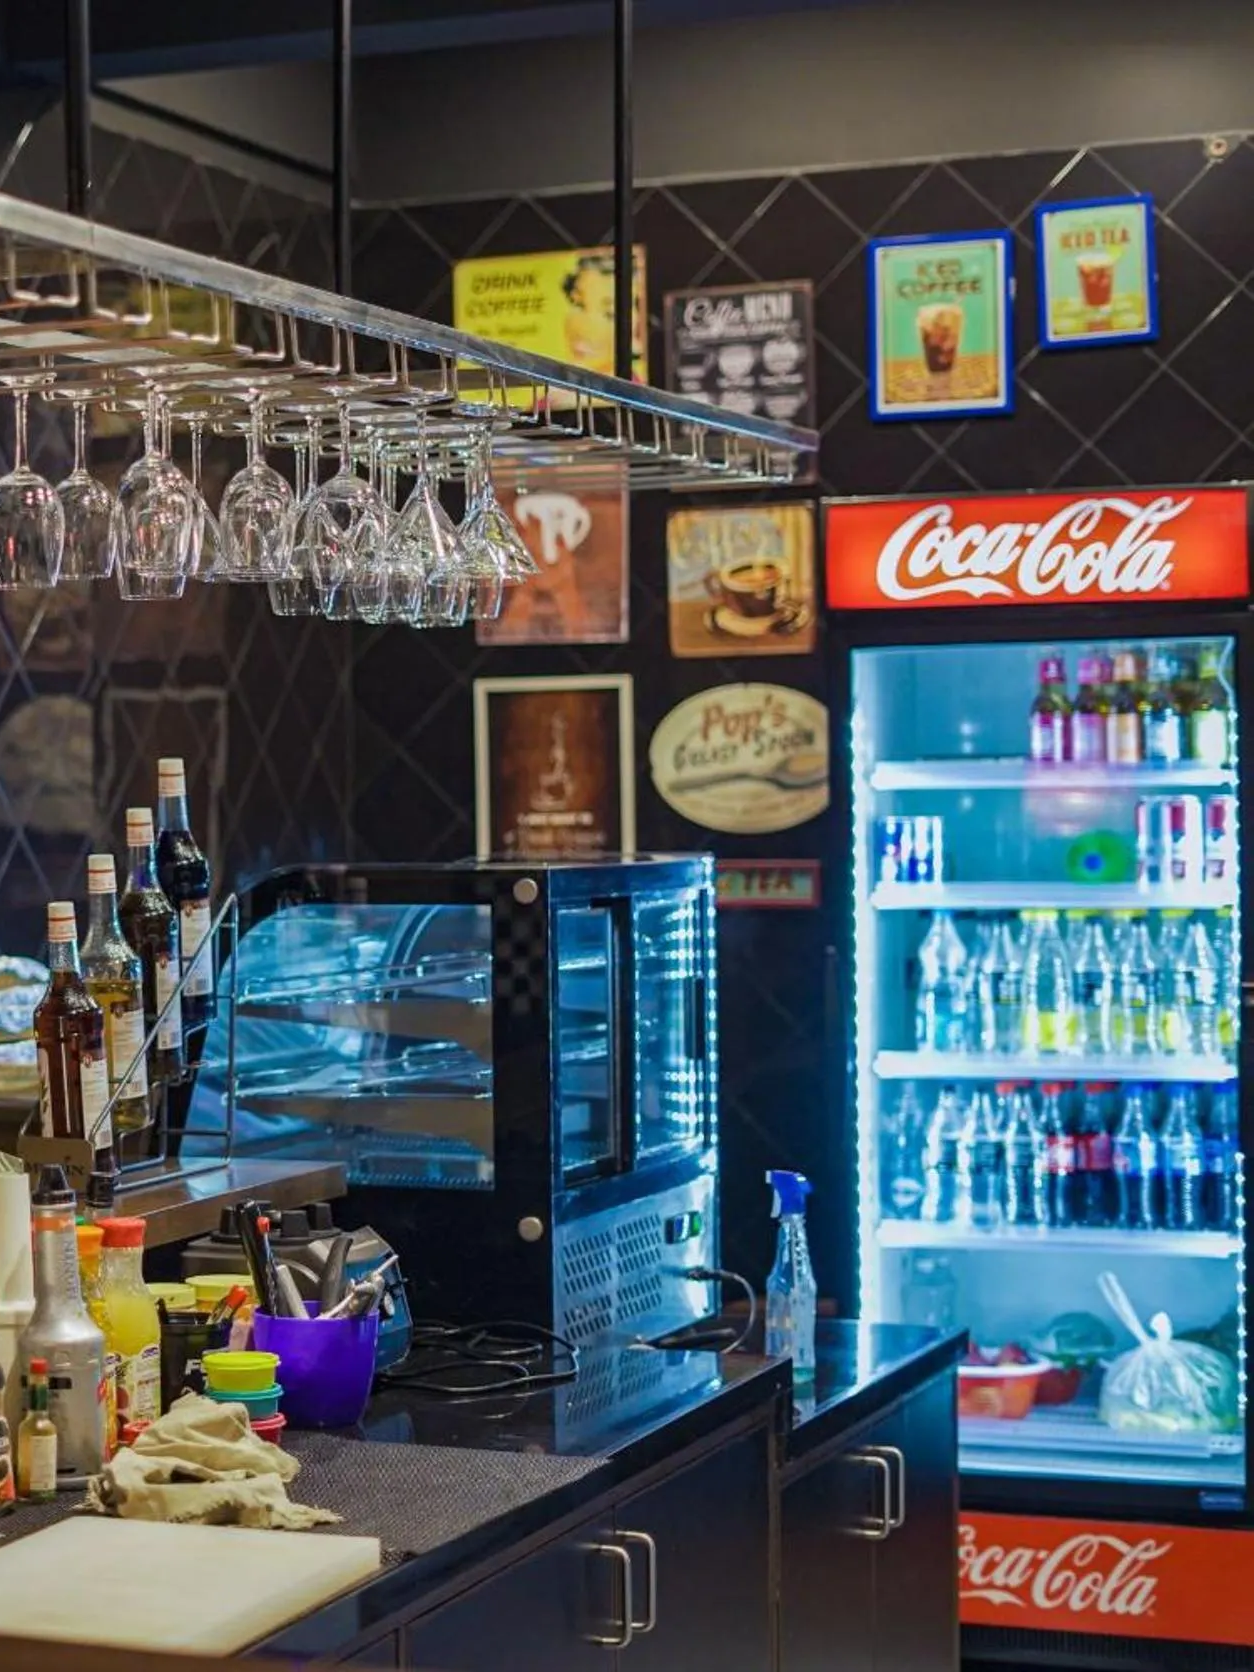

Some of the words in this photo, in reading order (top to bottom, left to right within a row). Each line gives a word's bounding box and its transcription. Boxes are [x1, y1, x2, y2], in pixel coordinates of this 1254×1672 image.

[876, 496, 1194, 601] Coca-Cola
[701, 693, 788, 744] Pop's
[958, 1524, 1174, 1616] oca-Cola
